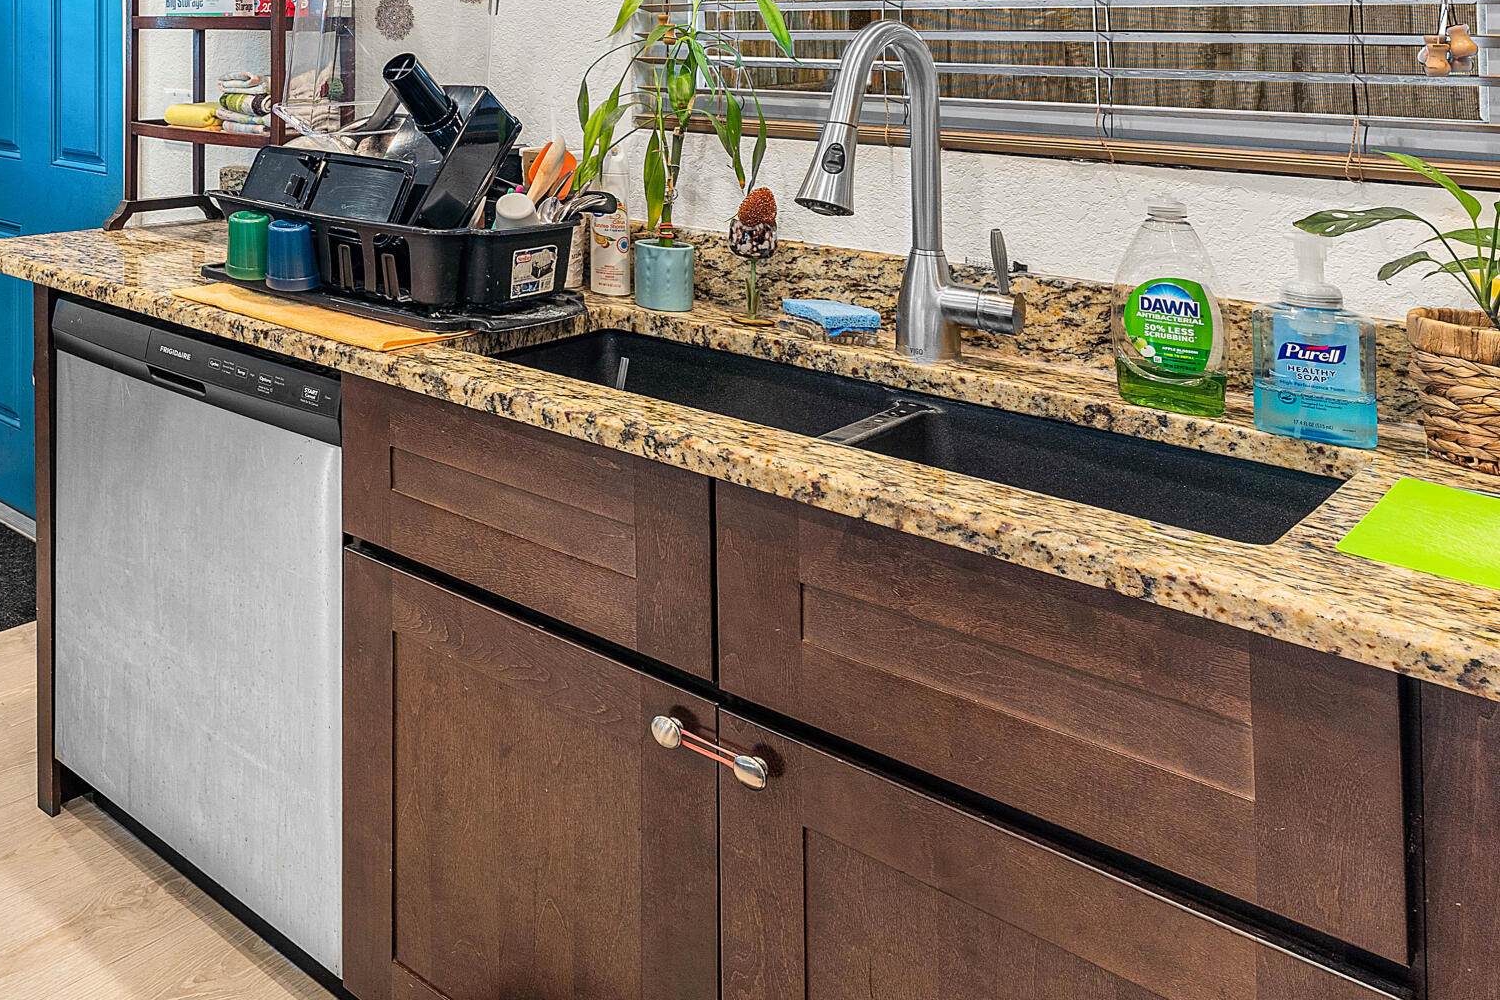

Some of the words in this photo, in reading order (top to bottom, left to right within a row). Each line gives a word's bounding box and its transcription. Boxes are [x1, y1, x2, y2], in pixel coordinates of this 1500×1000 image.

[235, 3, 253, 12] Storage
[1139, 295, 1200, 318] DAWN
[1136, 311, 1204, 326] ANTIBACTERIAL
[1144, 323, 1166, 333] 50%
[1168, 326, 1195, 337] LESS
[159, 345, 192, 361] FRIGIDAIRE
[1285, 343, 1341, 363] Purell
[1287, 364, 1336, 377] HEALTHY
[1297, 373, 1328, 383] SOAP
